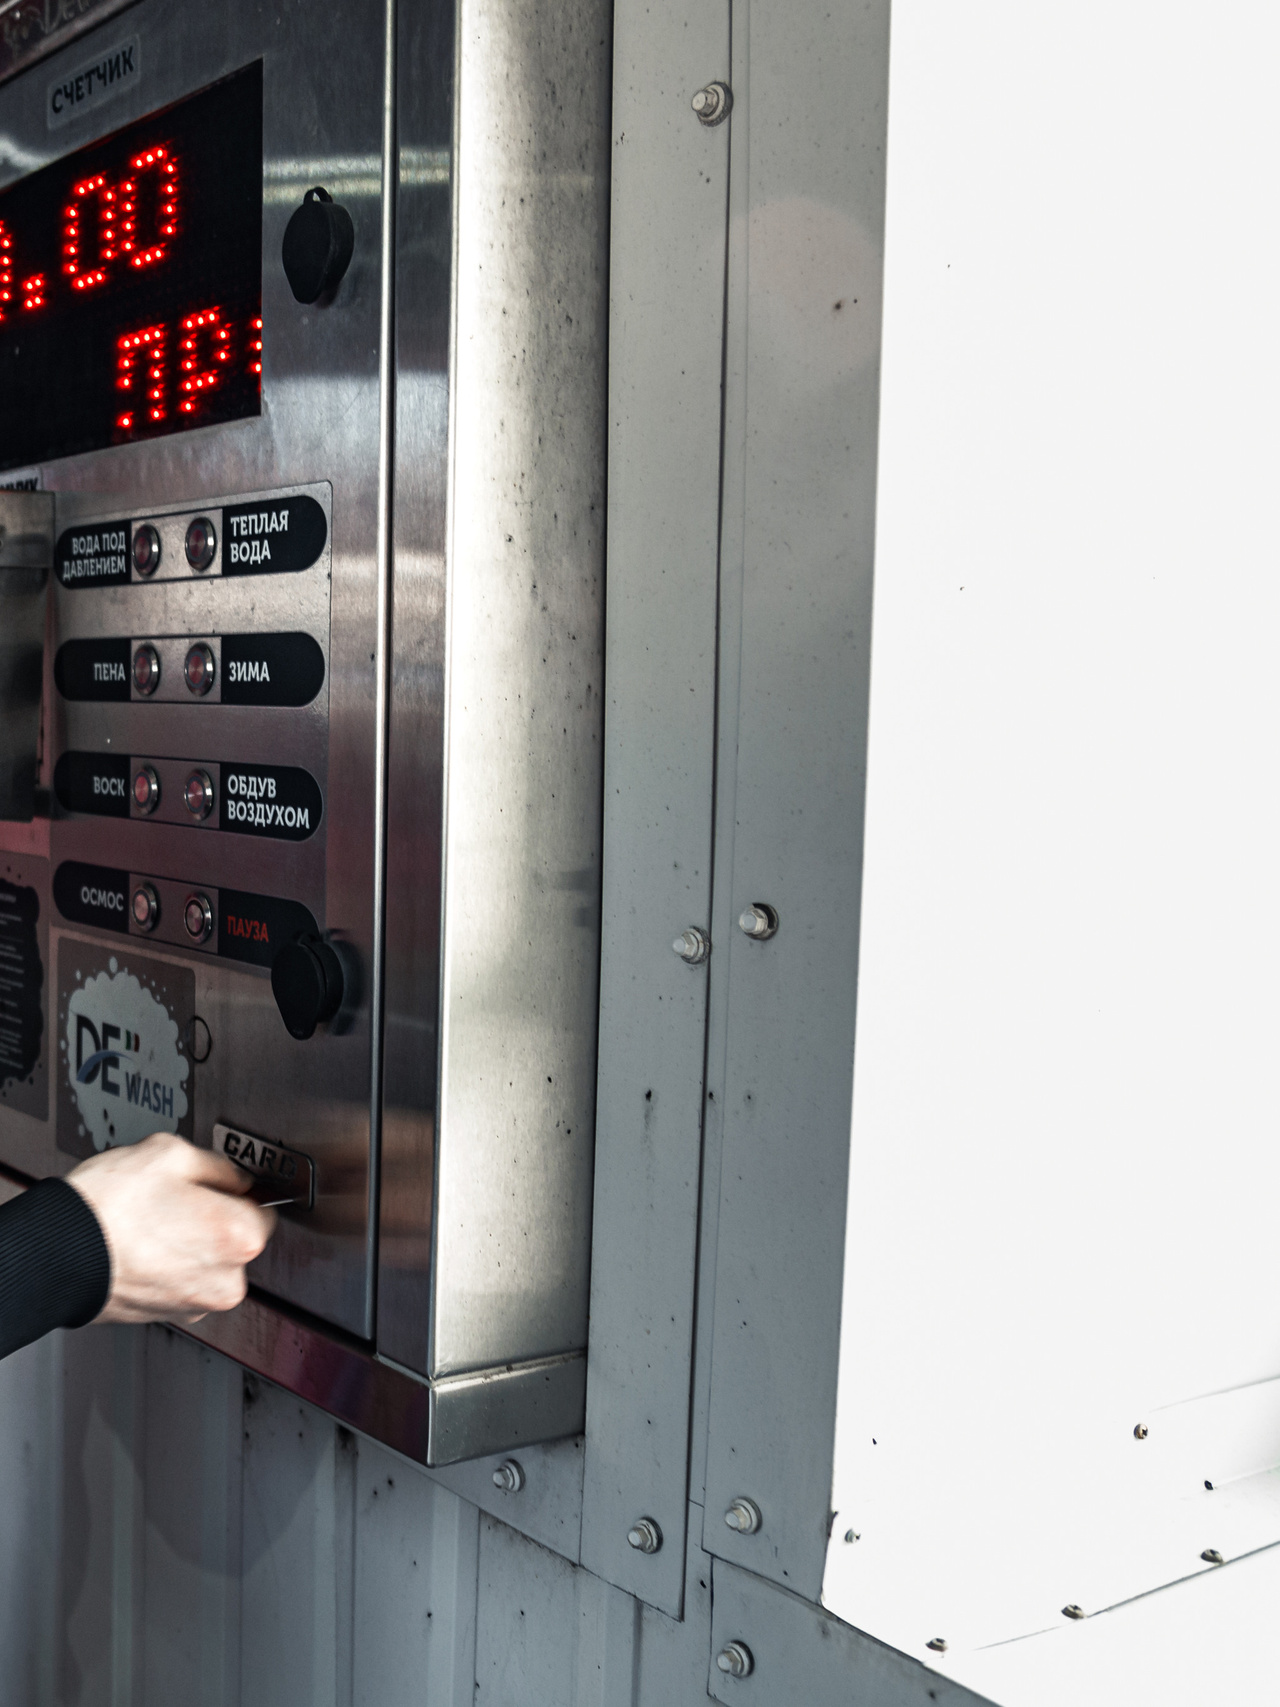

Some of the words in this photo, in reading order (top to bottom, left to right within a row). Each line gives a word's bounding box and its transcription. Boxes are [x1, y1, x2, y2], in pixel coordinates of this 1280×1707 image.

[51, 45, 135, 115] СЧЕТЧИК
[116, 306, 262, 427] ПР
[230, 509, 289, 536] ТЕПЛАЯ
[71, 535, 100, 556] ВОДА
[102, 531, 126, 554] ПОД
[230, 539, 271, 565] ВОДА
[62, 554, 126, 581] ДАВЛЕНИЕМ
[93, 662, 126, 682] ПЕНА
[229, 661, 270, 682] ЗИМА
[93, 775, 125, 797] ВОСК
[227, 774, 276, 800] ОБДУВ
[227, 799, 310, 829] ВОЗДУХОМ
[80, 885, 124, 912] ОСМОС
[227, 915, 269, 943] ПАУЗА
[125, 1072, 174, 1118] WASH
[223, 1132, 298, 1180] CARD
